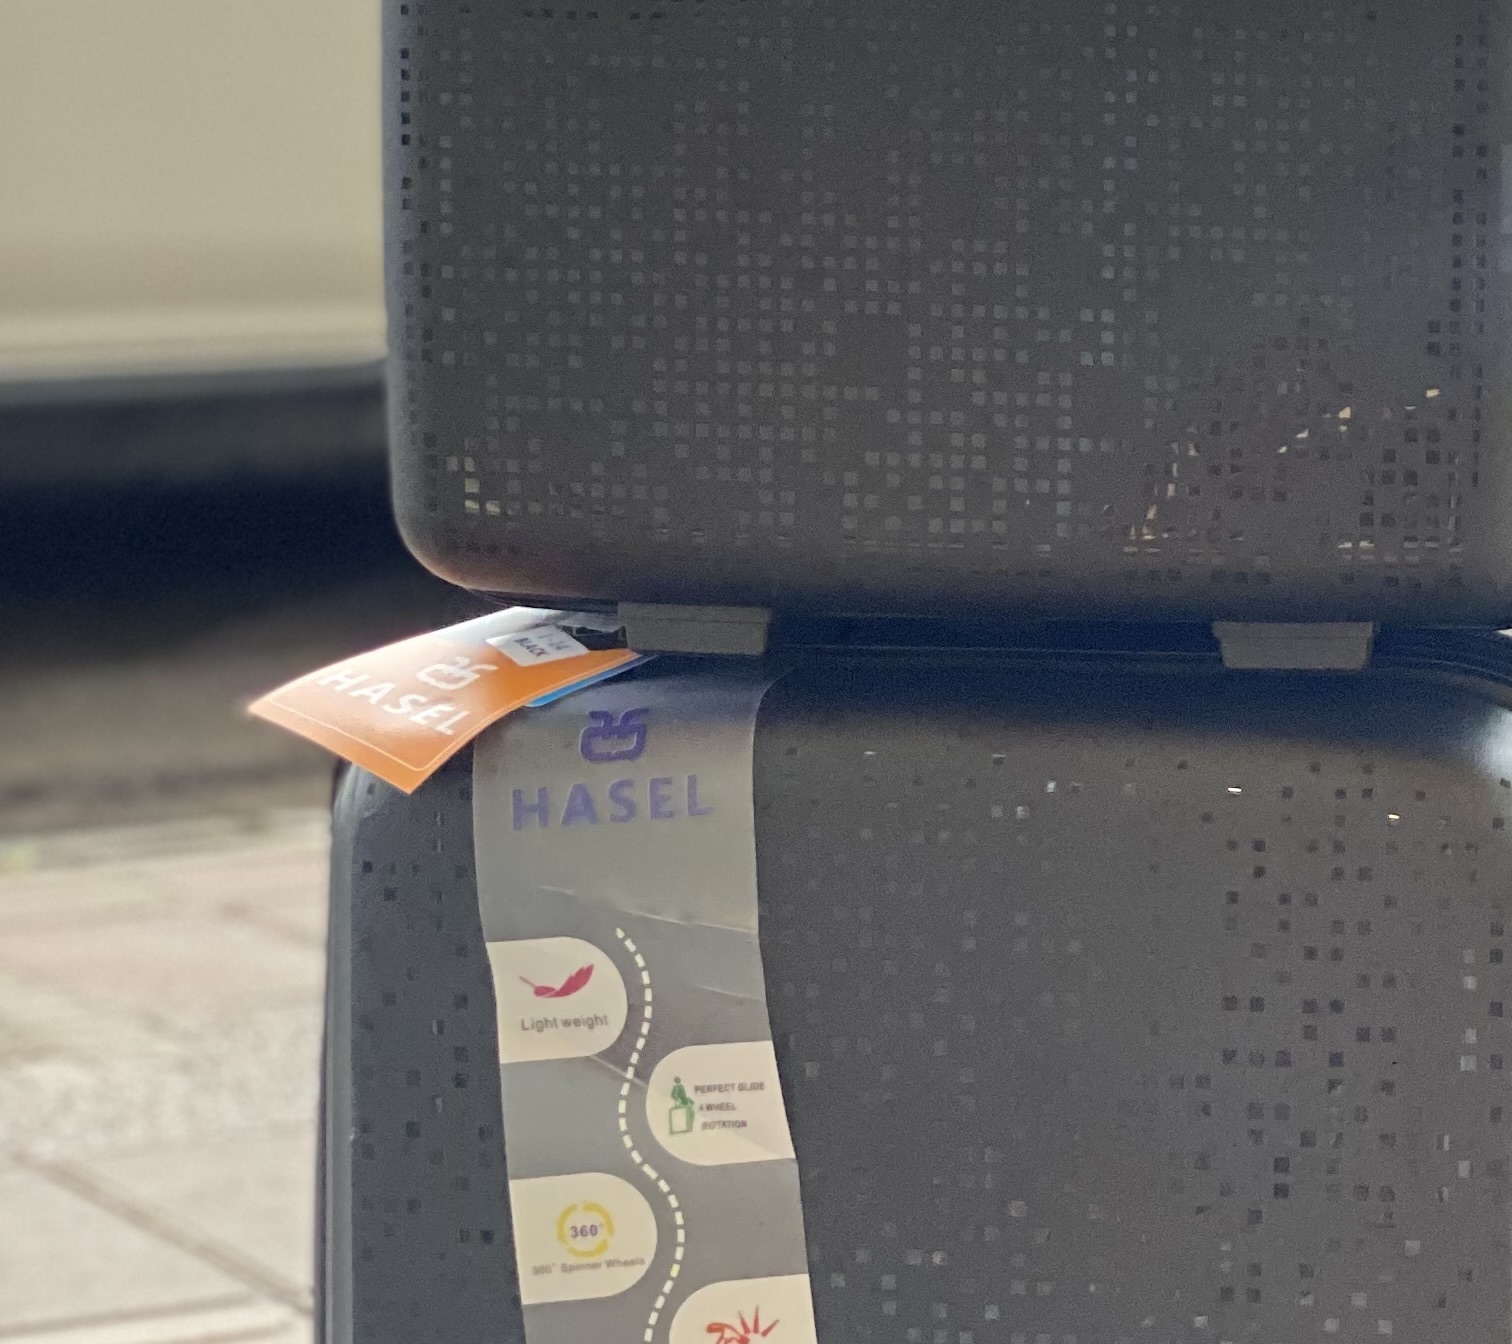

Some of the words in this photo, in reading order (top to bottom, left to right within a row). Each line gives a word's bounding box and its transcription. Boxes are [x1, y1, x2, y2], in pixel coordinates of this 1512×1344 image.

[317, 668, 472, 737] HASEL
[511, 773, 713, 832] HASEL
[520, 1015, 559, 1032] Light
[562, 1014, 609, 1030] weight
[694, 1084, 735, 1094] PERFECT
[702, 1120, 747, 1130] ROTATION
[560, 1261, 603, 1274] Spinner
